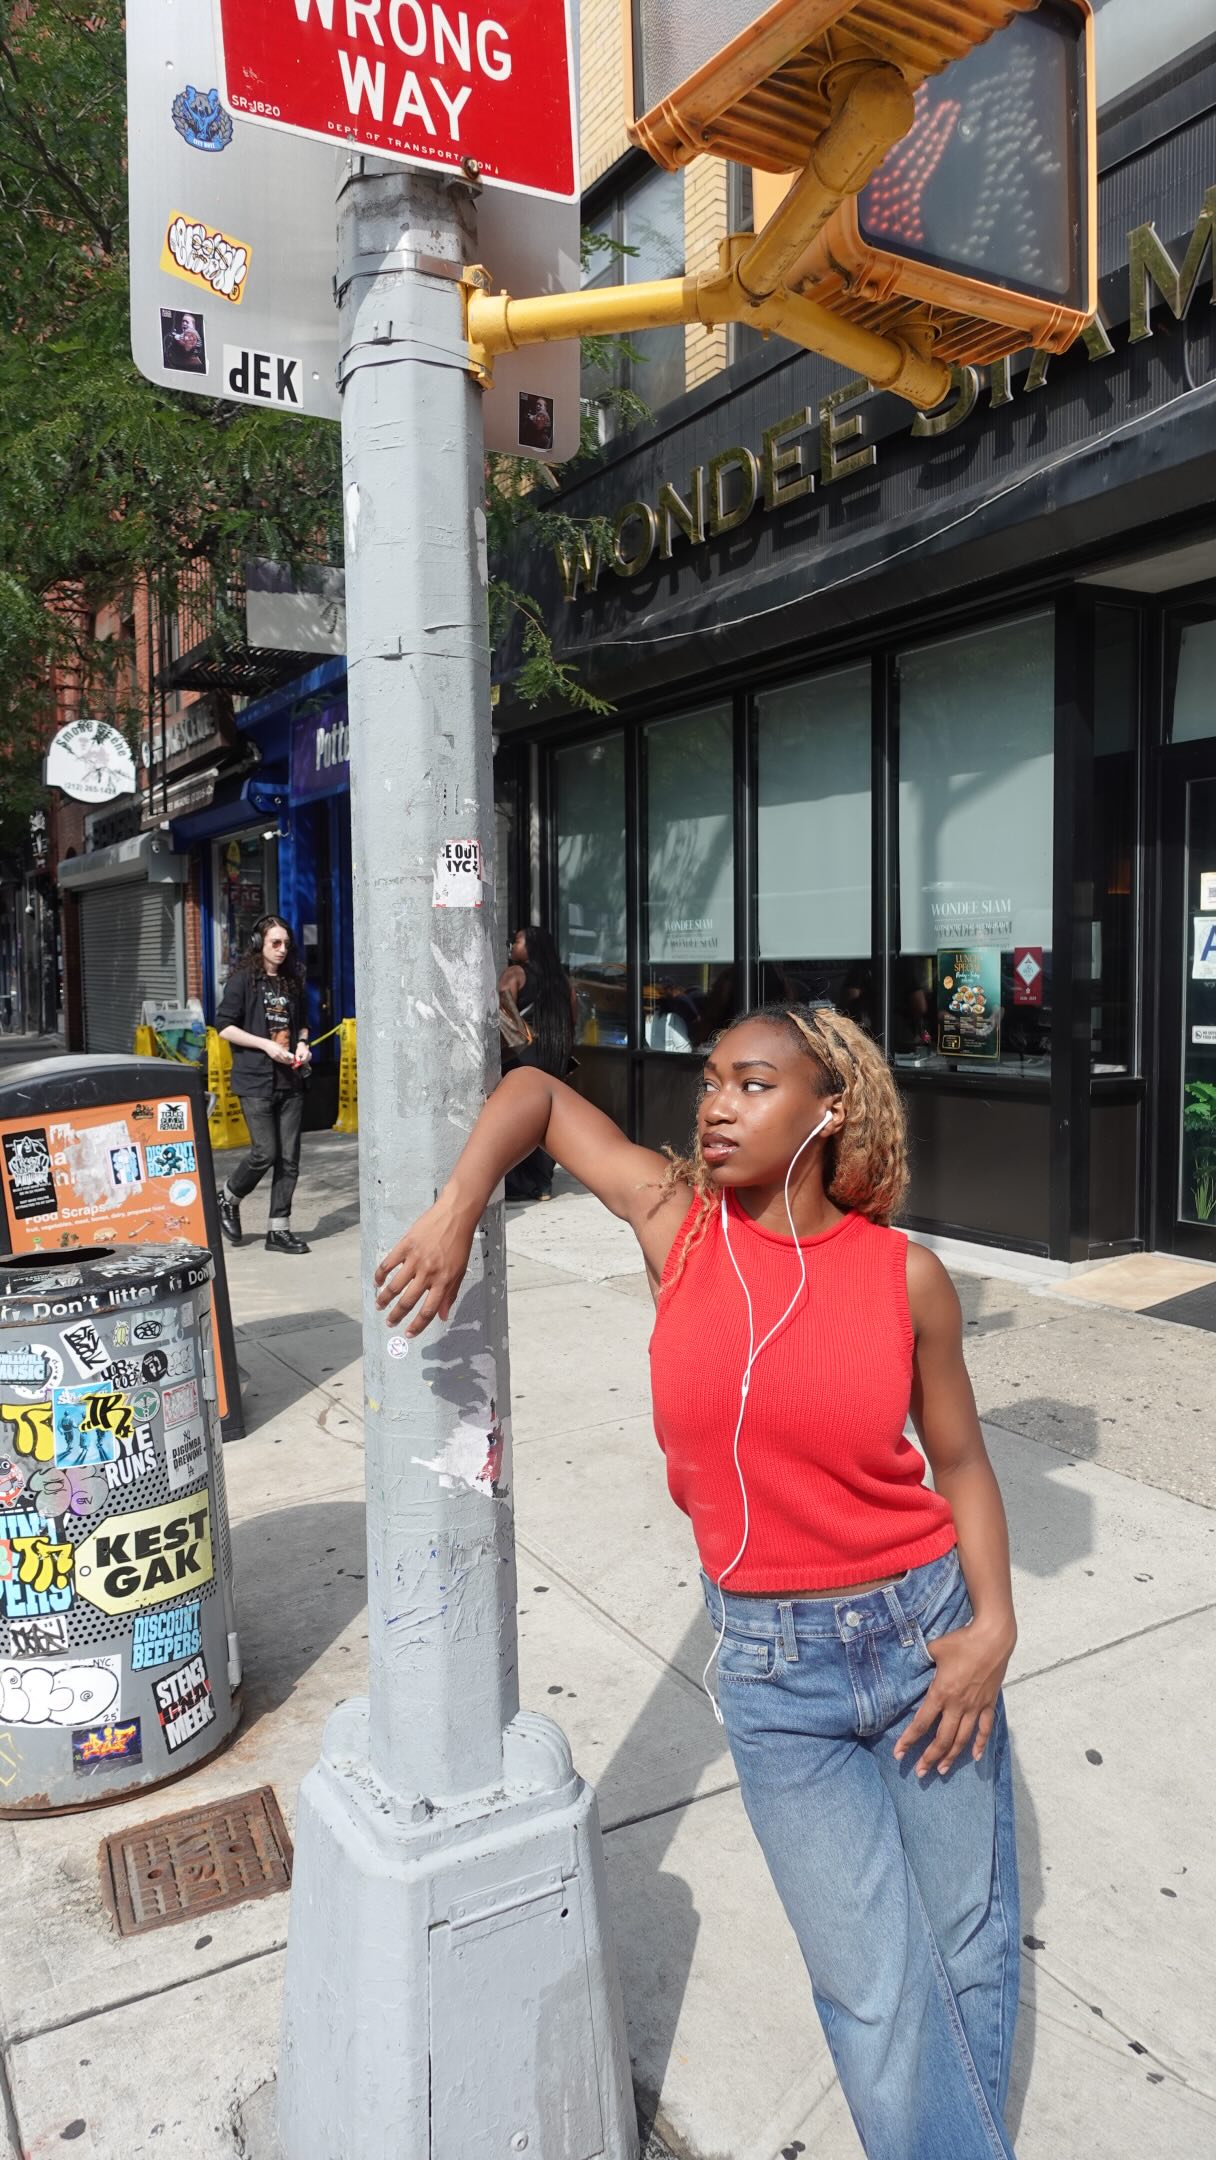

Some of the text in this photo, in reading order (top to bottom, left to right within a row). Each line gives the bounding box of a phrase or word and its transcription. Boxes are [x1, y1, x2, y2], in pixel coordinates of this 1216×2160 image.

[293, 0, 512, 81] WRONG
[337, 49, 472, 141] WAY
[327, 121, 358, 137] DEPT
[366, 131, 380, 141] OF
[228, 351, 299, 403] dEK
[33, 1284, 159, 1319] Don't litter
[104, 1448, 157, 1490] RUNS
[96, 1507, 208, 1568] KEST
[103, 1542, 202, 1598] GAK
[132, 1628, 201, 1671] BEEPERS
[134, 1604, 201, 1644] DISCOUNT
[165, 1697, 215, 1750] MEEK
